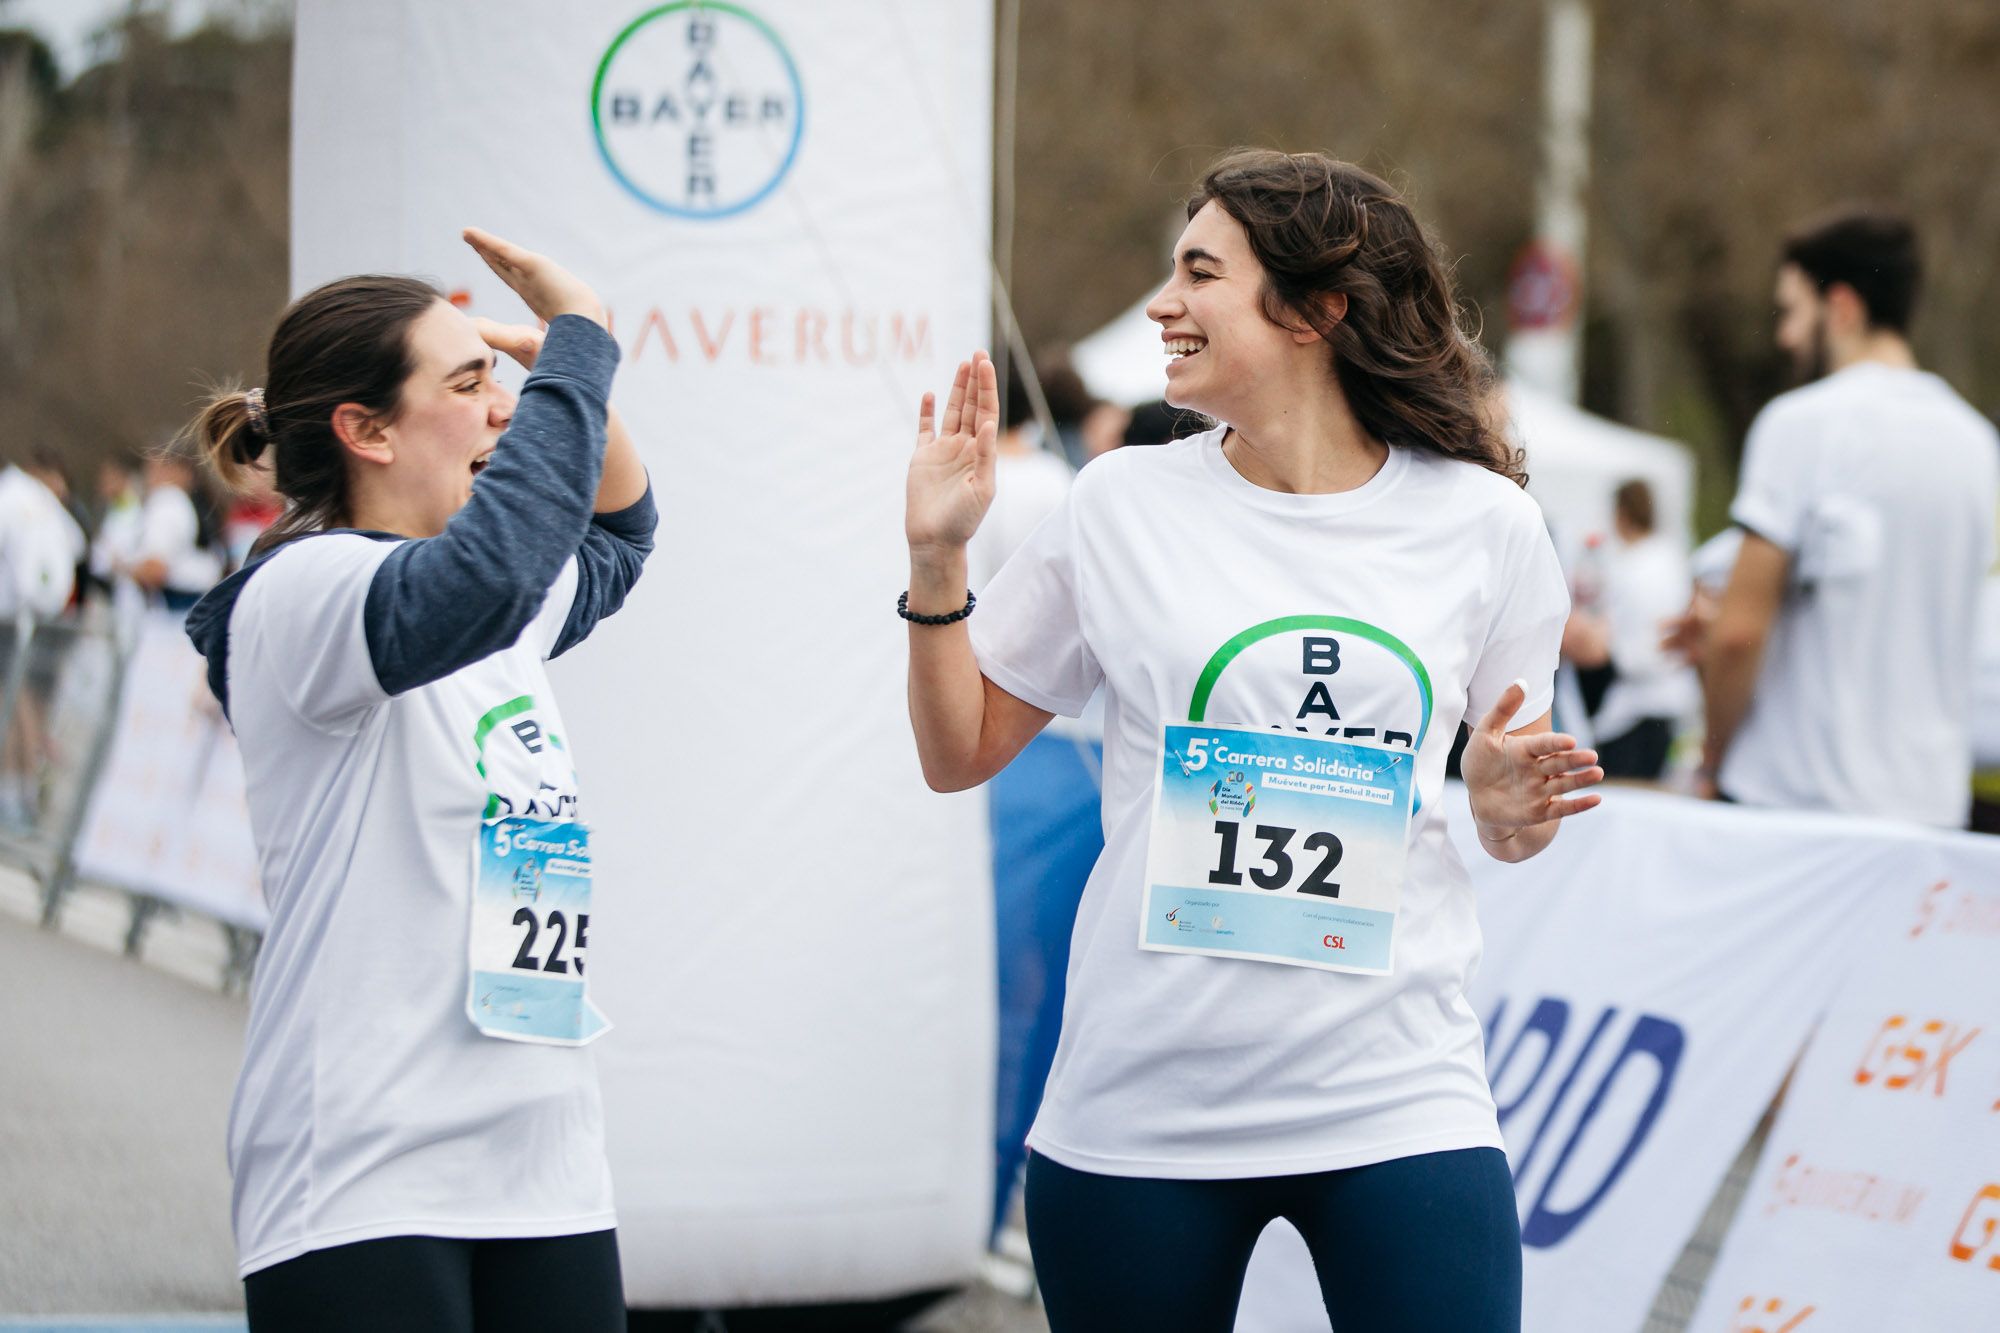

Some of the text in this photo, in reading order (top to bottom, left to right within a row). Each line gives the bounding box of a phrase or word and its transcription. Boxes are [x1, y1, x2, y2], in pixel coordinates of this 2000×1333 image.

[611, 94, 786, 124] BAYER
[685, 20, 716, 203] BAYER
[1214, 746, 1288, 769] Carrera
[1292, 754, 1374, 781] Solidaria
[1310, 783, 1326, 792] por
[1338, 785, 1363, 797] Salud
[1365, 789, 1390, 801] Renal
[1209, 820, 1344, 899] 132
[1323, 934, 1346, 950] CSL
